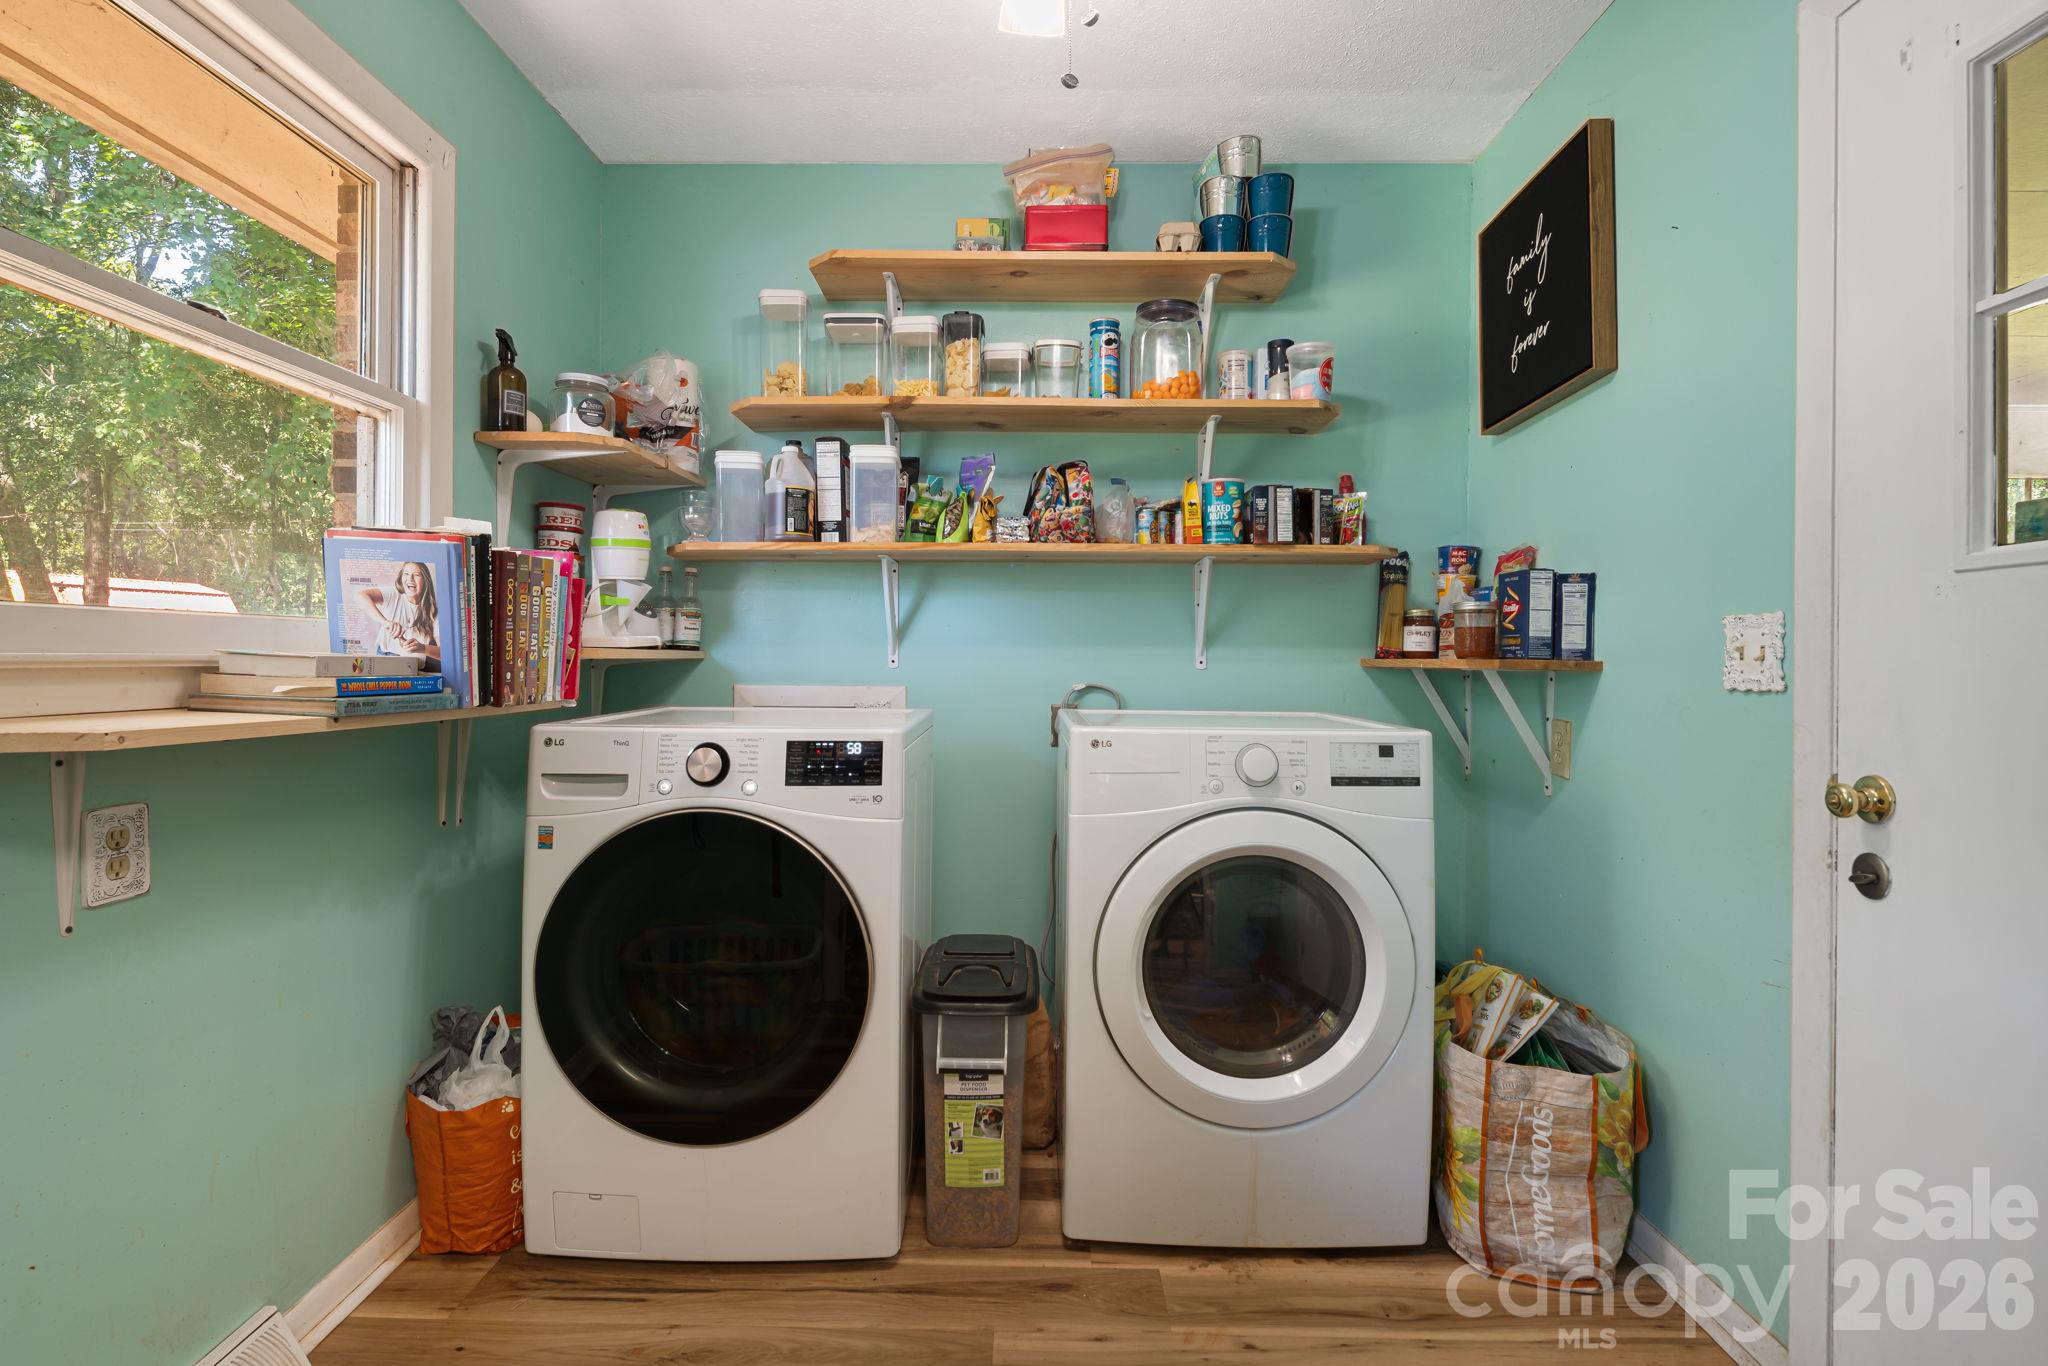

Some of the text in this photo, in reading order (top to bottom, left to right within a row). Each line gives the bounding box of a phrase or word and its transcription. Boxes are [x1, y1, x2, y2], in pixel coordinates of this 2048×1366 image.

[1506, 212, 1552, 294] family
[1523, 288, 1537, 315] is
[1511, 320, 1550, 373] forever
[1207, 504, 1231, 513] MIXED
[1209, 512, 1228, 520] NUTS
[519, 584, 529, 616] GOOD
[529, 585, 542, 660] GOOD EATS
[541, 586, 554, 658] GOOD EATS
[550, 599, 558, 646] everyday
[505, 631, 513, 661] EATS
[517, 630, 526, 658] EATS
[348, 682, 365, 692] WHOLE
[379, 681, 398, 689] PEPPER
[554, 738, 565, 746] LG
[613, 739, 630, 747] ThinQ
[847, 742, 862, 755] 58
[1101, 740, 1112, 748] LG
